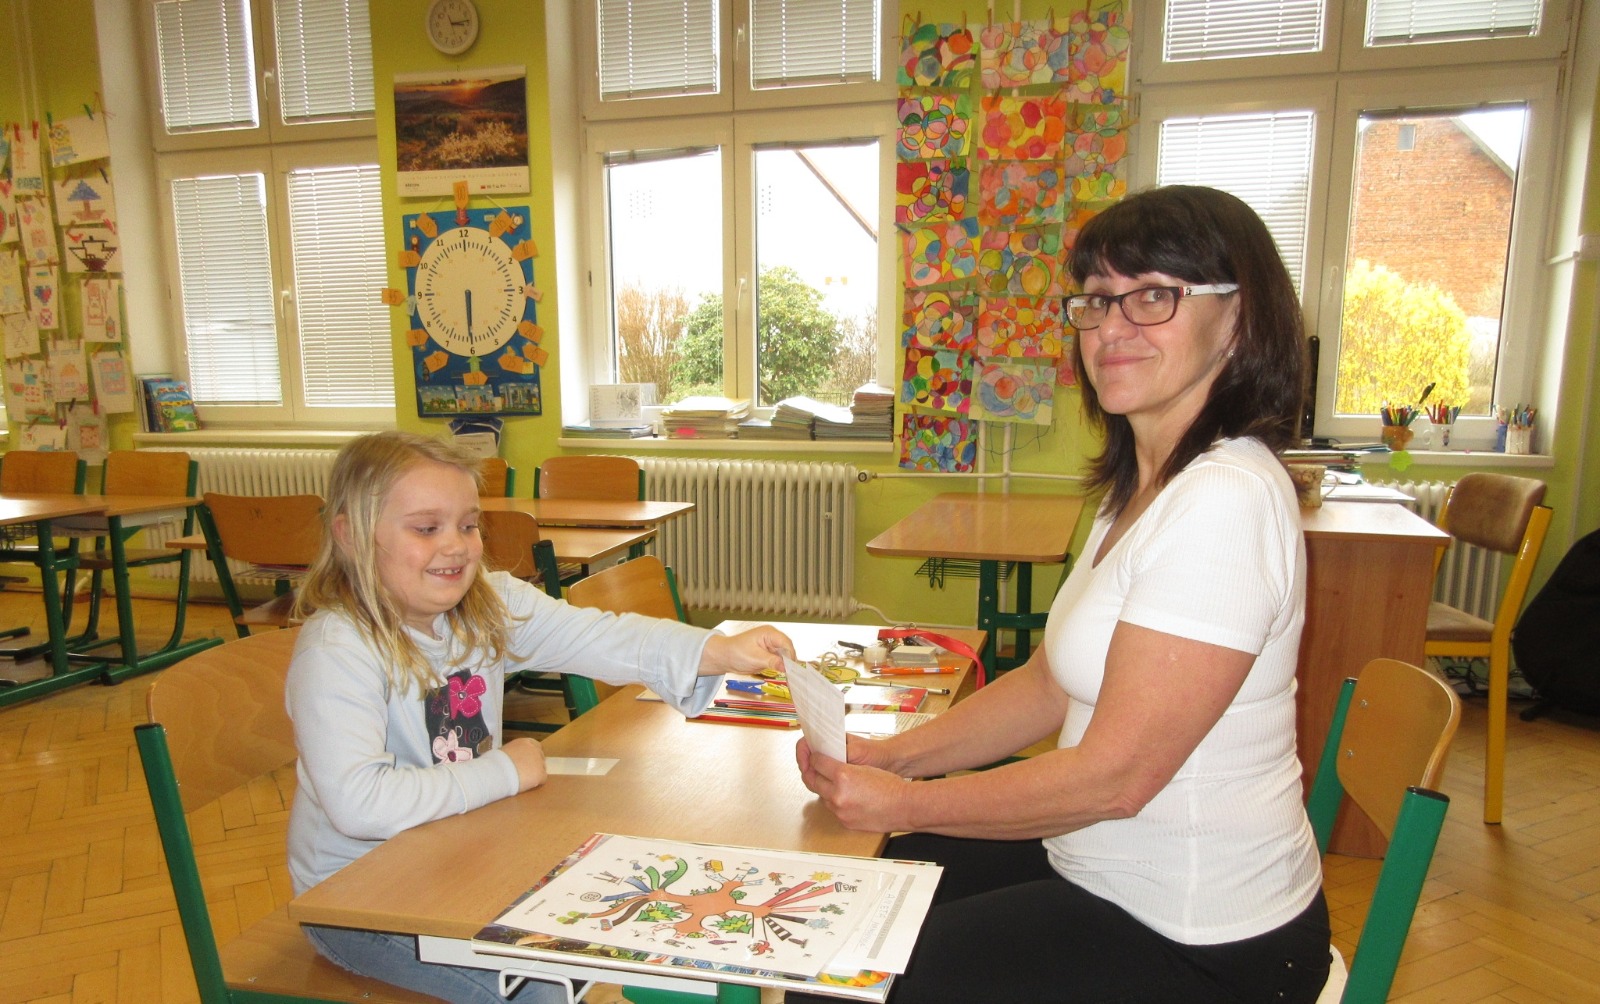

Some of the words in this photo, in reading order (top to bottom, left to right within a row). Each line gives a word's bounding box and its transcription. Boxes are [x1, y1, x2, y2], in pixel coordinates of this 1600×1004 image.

[459, 230, 469, 238] 12
[518, 286, 524, 294] 3
[417, 292, 422, 300] 9
